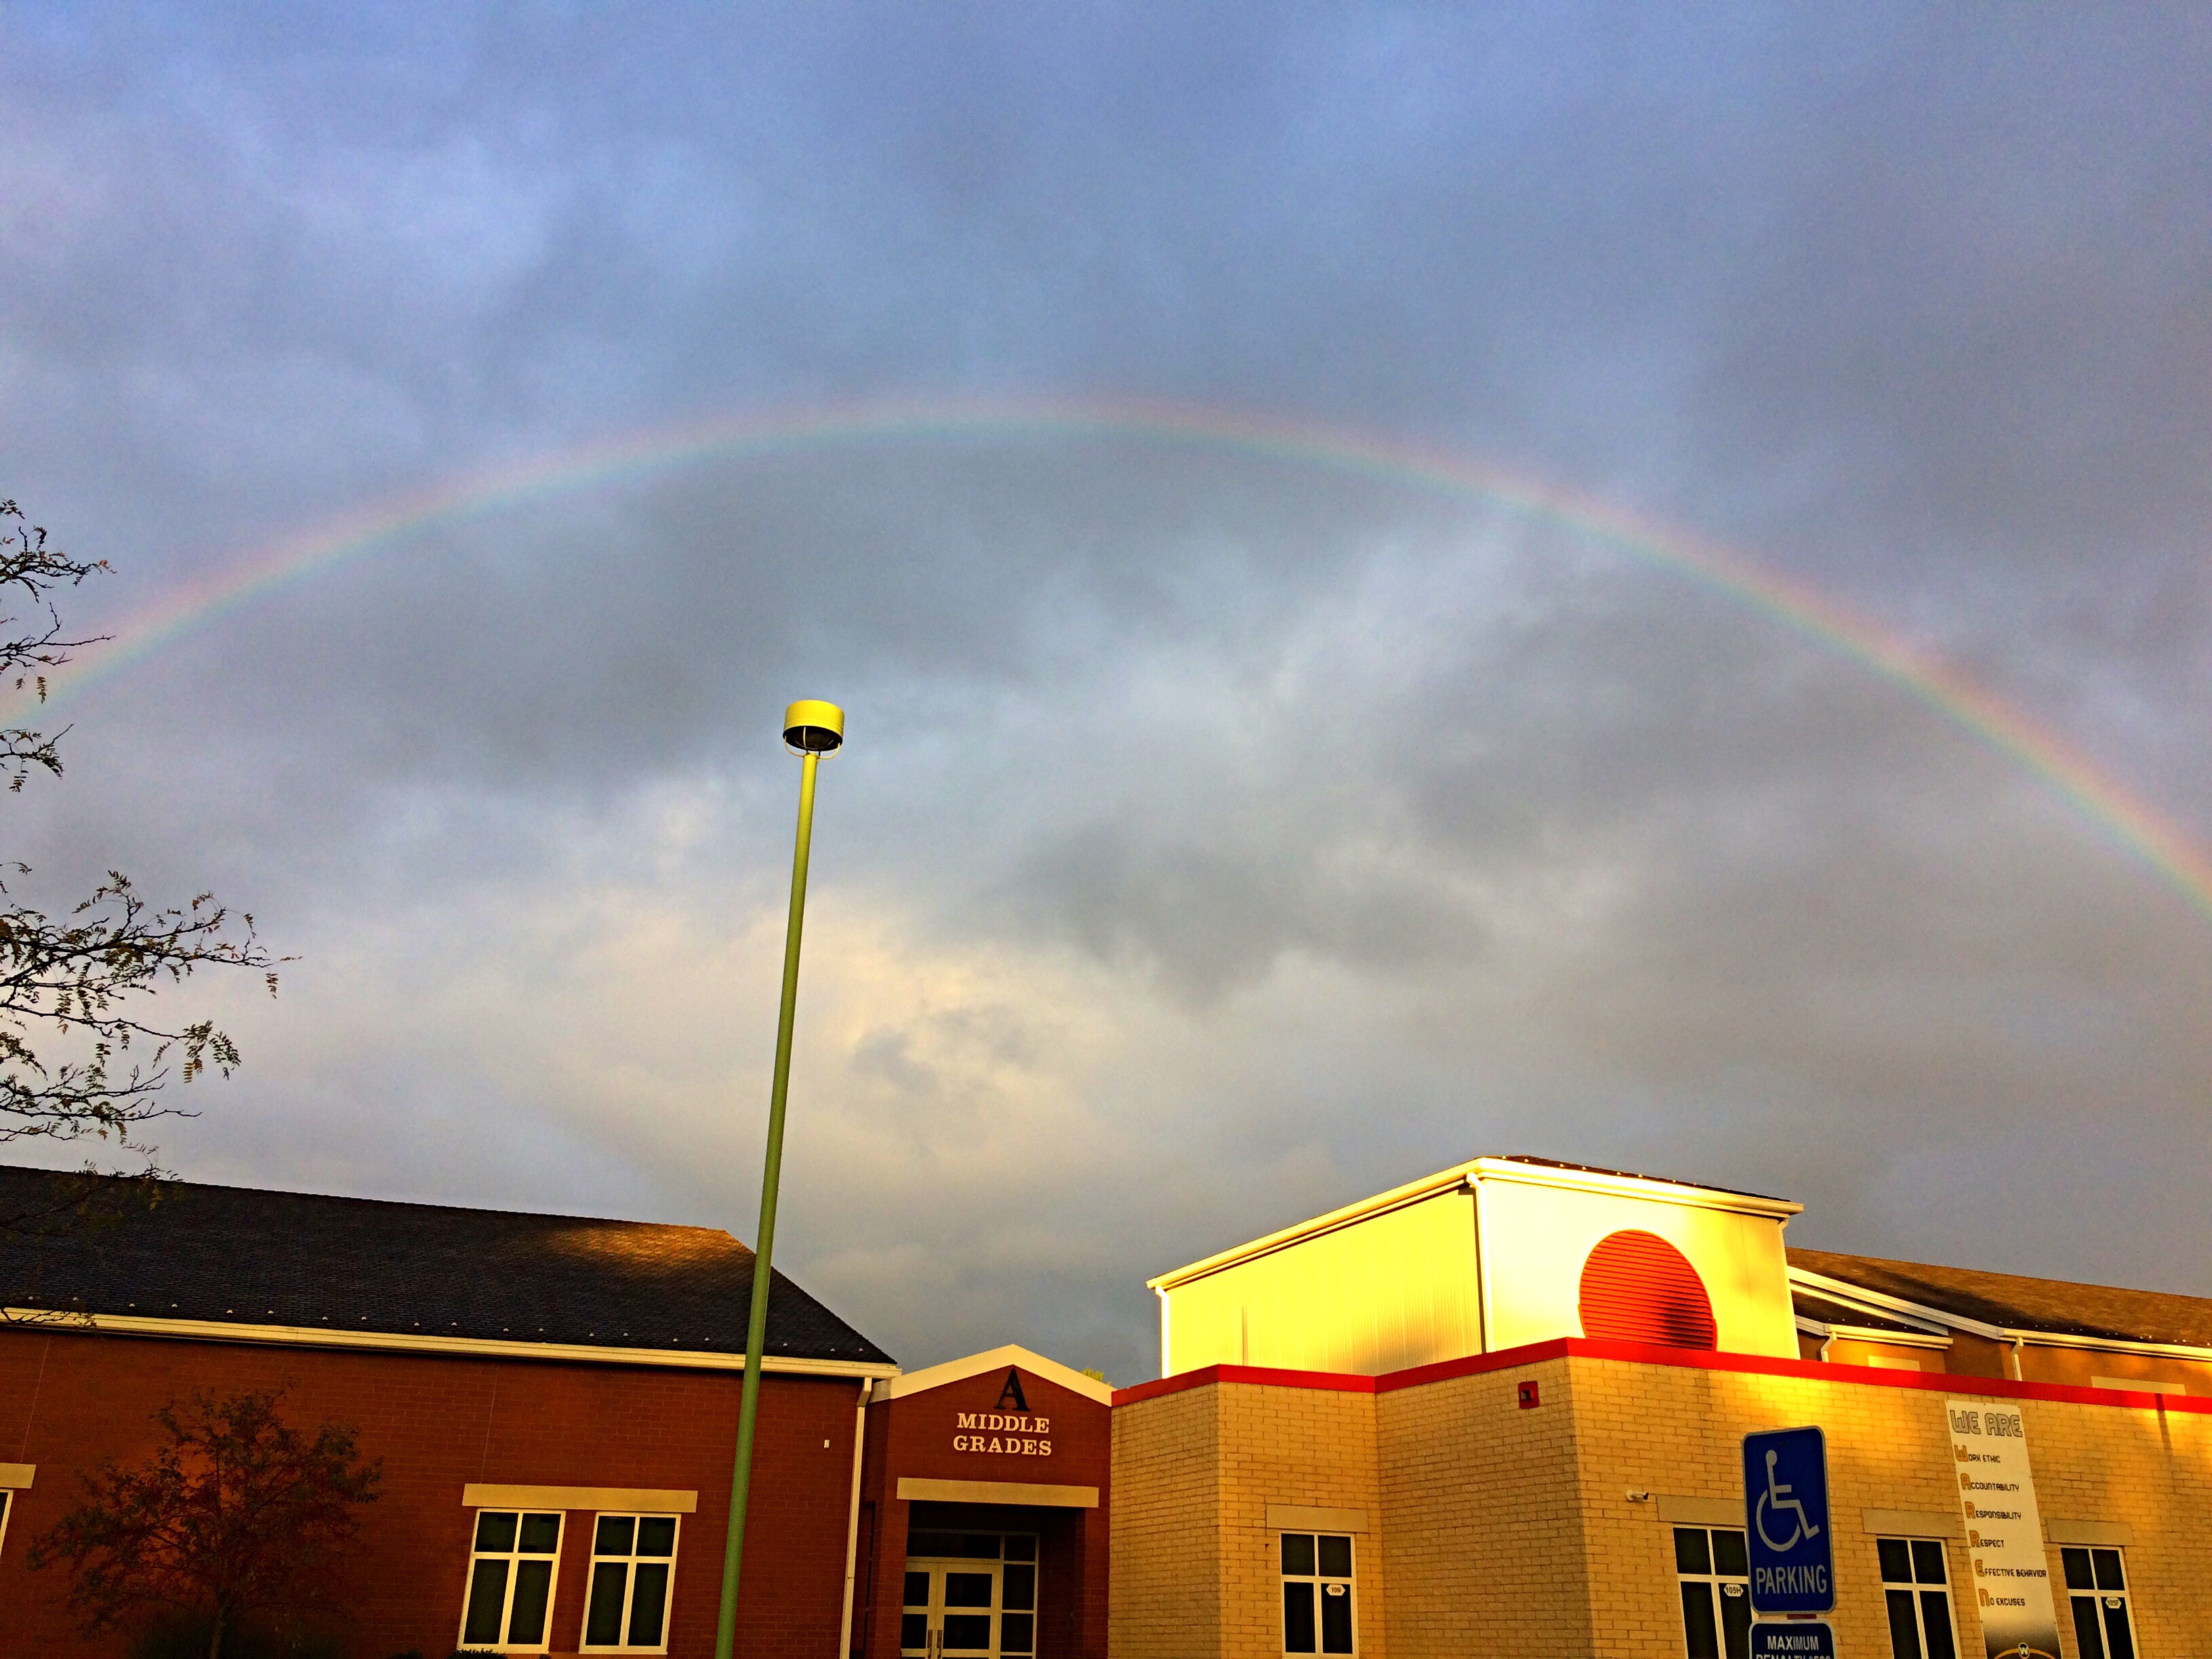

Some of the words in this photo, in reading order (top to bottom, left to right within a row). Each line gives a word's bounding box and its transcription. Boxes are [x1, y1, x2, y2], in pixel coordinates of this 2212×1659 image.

[993, 1368, 1031, 1411] A
[956, 1412, 1050, 1433] MIDDLE
[1949, 1410, 1982, 1435] WE
[1984, 1412, 2023, 1437] ARE
[953, 1435, 1052, 1456] GRADES
[1954, 1444, 1981, 1462] WORK
[1982, 1454, 2001, 1463] ETHIC
[1960, 1473, 2020, 1492] ACCOUNTABILITY
[1965, 1501, 2022, 1519] RESPONSIBILITY
[1969, 1530, 2005, 1548] RESPECT
[1974, 1559, 2015, 1577] EFFECTIVE
[2016, 1568, 2047, 1578] BEHAVIOR
[1755, 1564, 1827, 1595] PARKING
[1725, 1586, 1742, 1594] 105H
[1978, 1588, 1994, 1607] NO
[1996, 1597, 2026, 1606] EXCUSES
[1767, 1635, 1820, 1651] MAXIMUM
